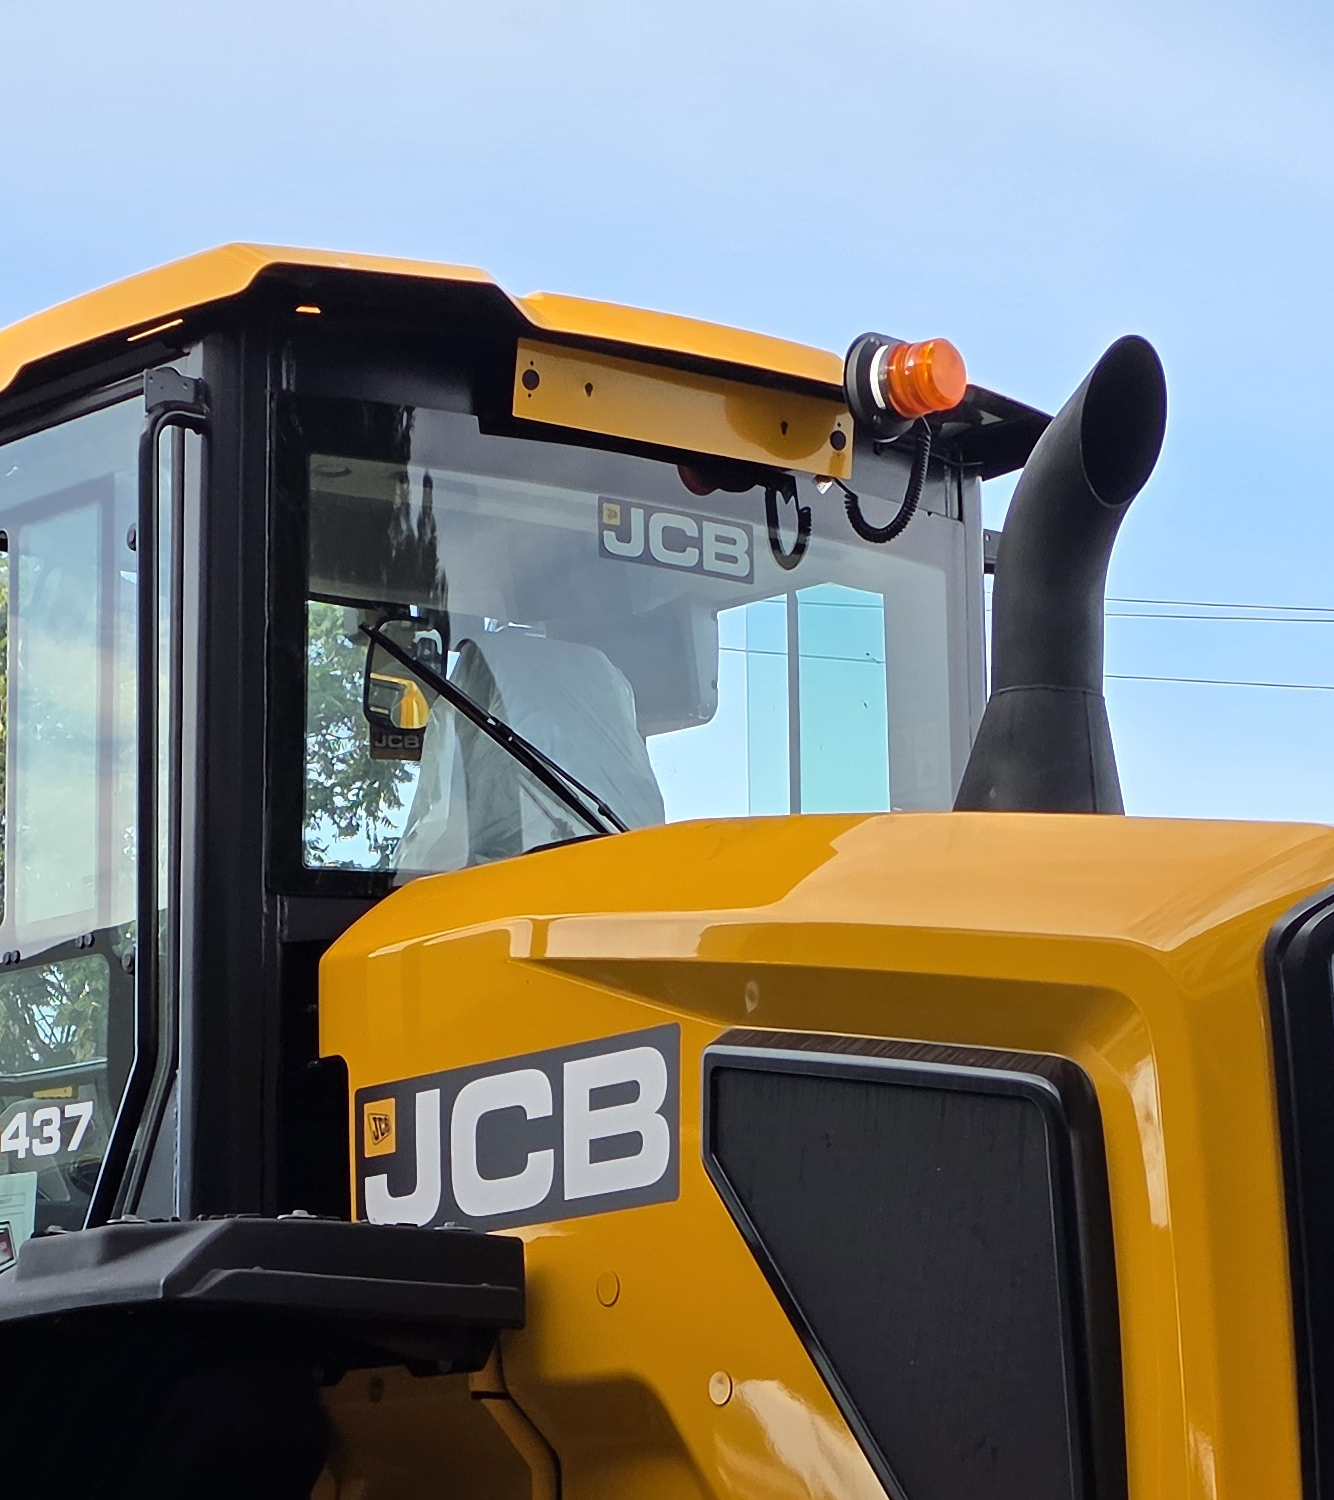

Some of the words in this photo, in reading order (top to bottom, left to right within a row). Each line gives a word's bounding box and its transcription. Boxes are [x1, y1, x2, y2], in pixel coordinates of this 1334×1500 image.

[603, 508, 751, 577] JCB
[375, 735, 420, 748] JCB
[0, 1101, 94, 1159] 437
[364, 1046, 670, 1228] JCB
